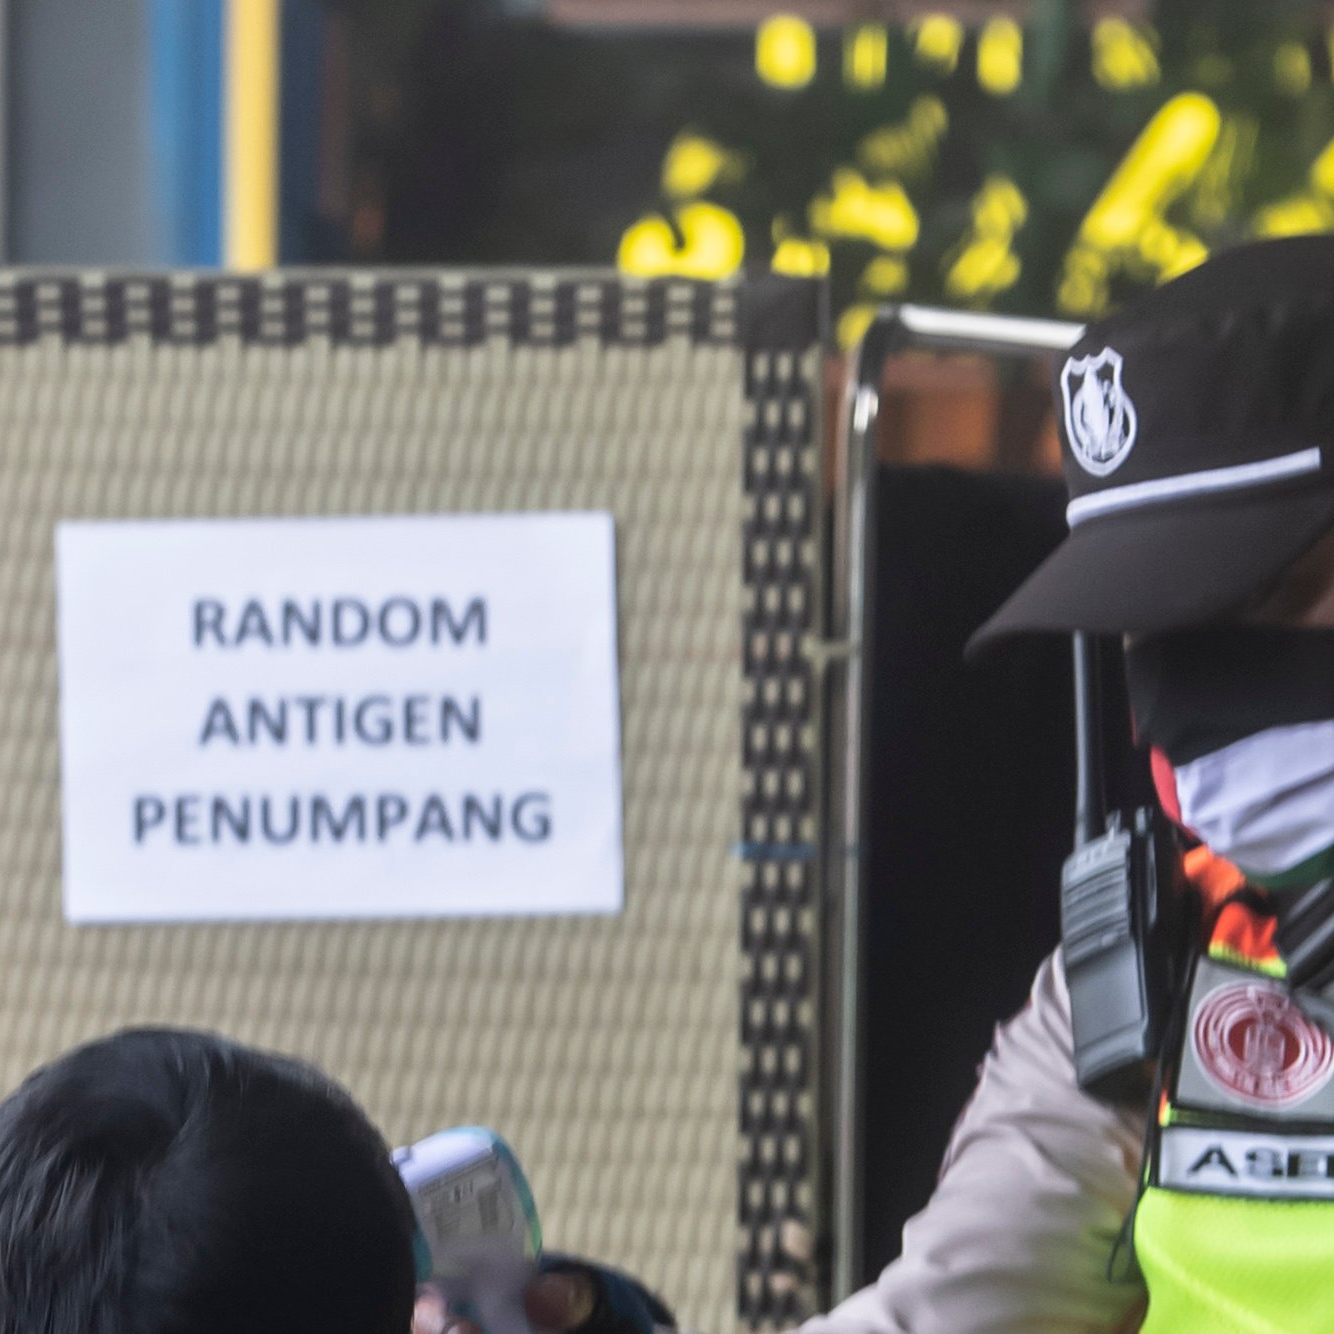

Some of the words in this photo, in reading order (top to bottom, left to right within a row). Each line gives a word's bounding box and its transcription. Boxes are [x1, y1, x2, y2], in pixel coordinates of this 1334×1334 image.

[191, 596, 489, 649] RANDOM
[198, 694, 483, 748] ANTIGEN
[132, 791, 553, 846] PENUMPANG
